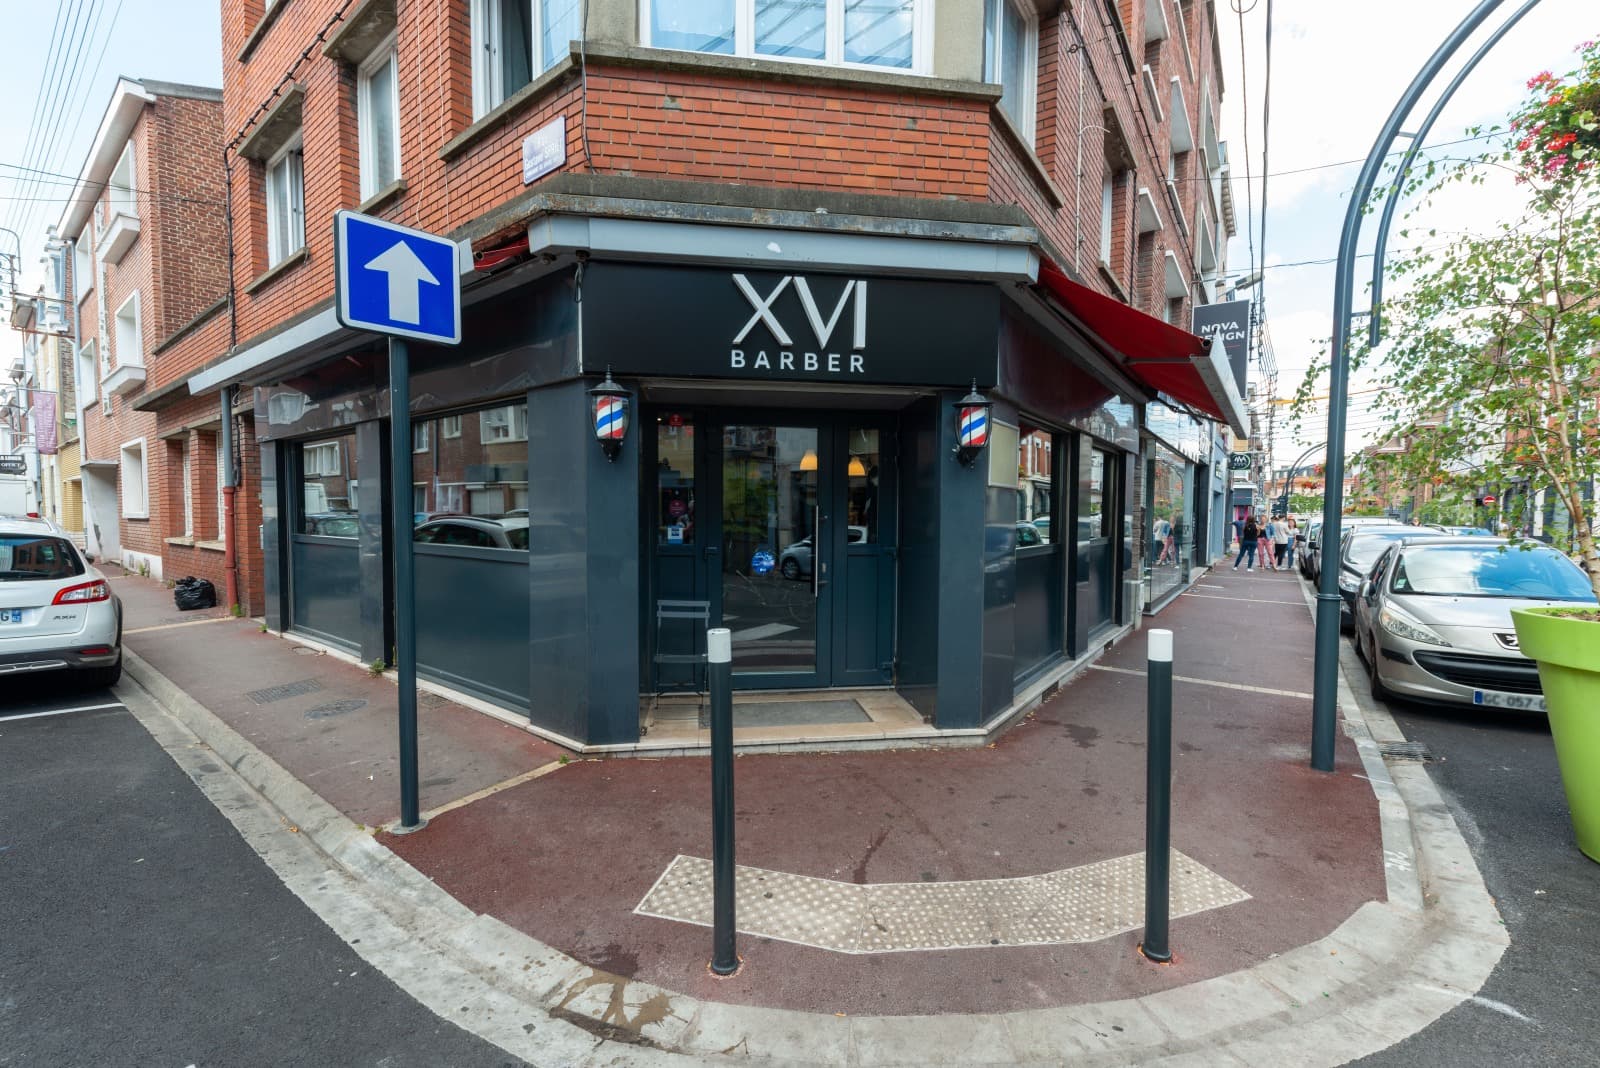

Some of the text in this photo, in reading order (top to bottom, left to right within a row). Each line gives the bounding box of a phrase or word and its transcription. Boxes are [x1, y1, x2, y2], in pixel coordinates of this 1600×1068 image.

[732, 274, 867, 350] XVI
[1201, 321, 1239, 333] NOVA
[731, 350, 864, 372] BARBER
